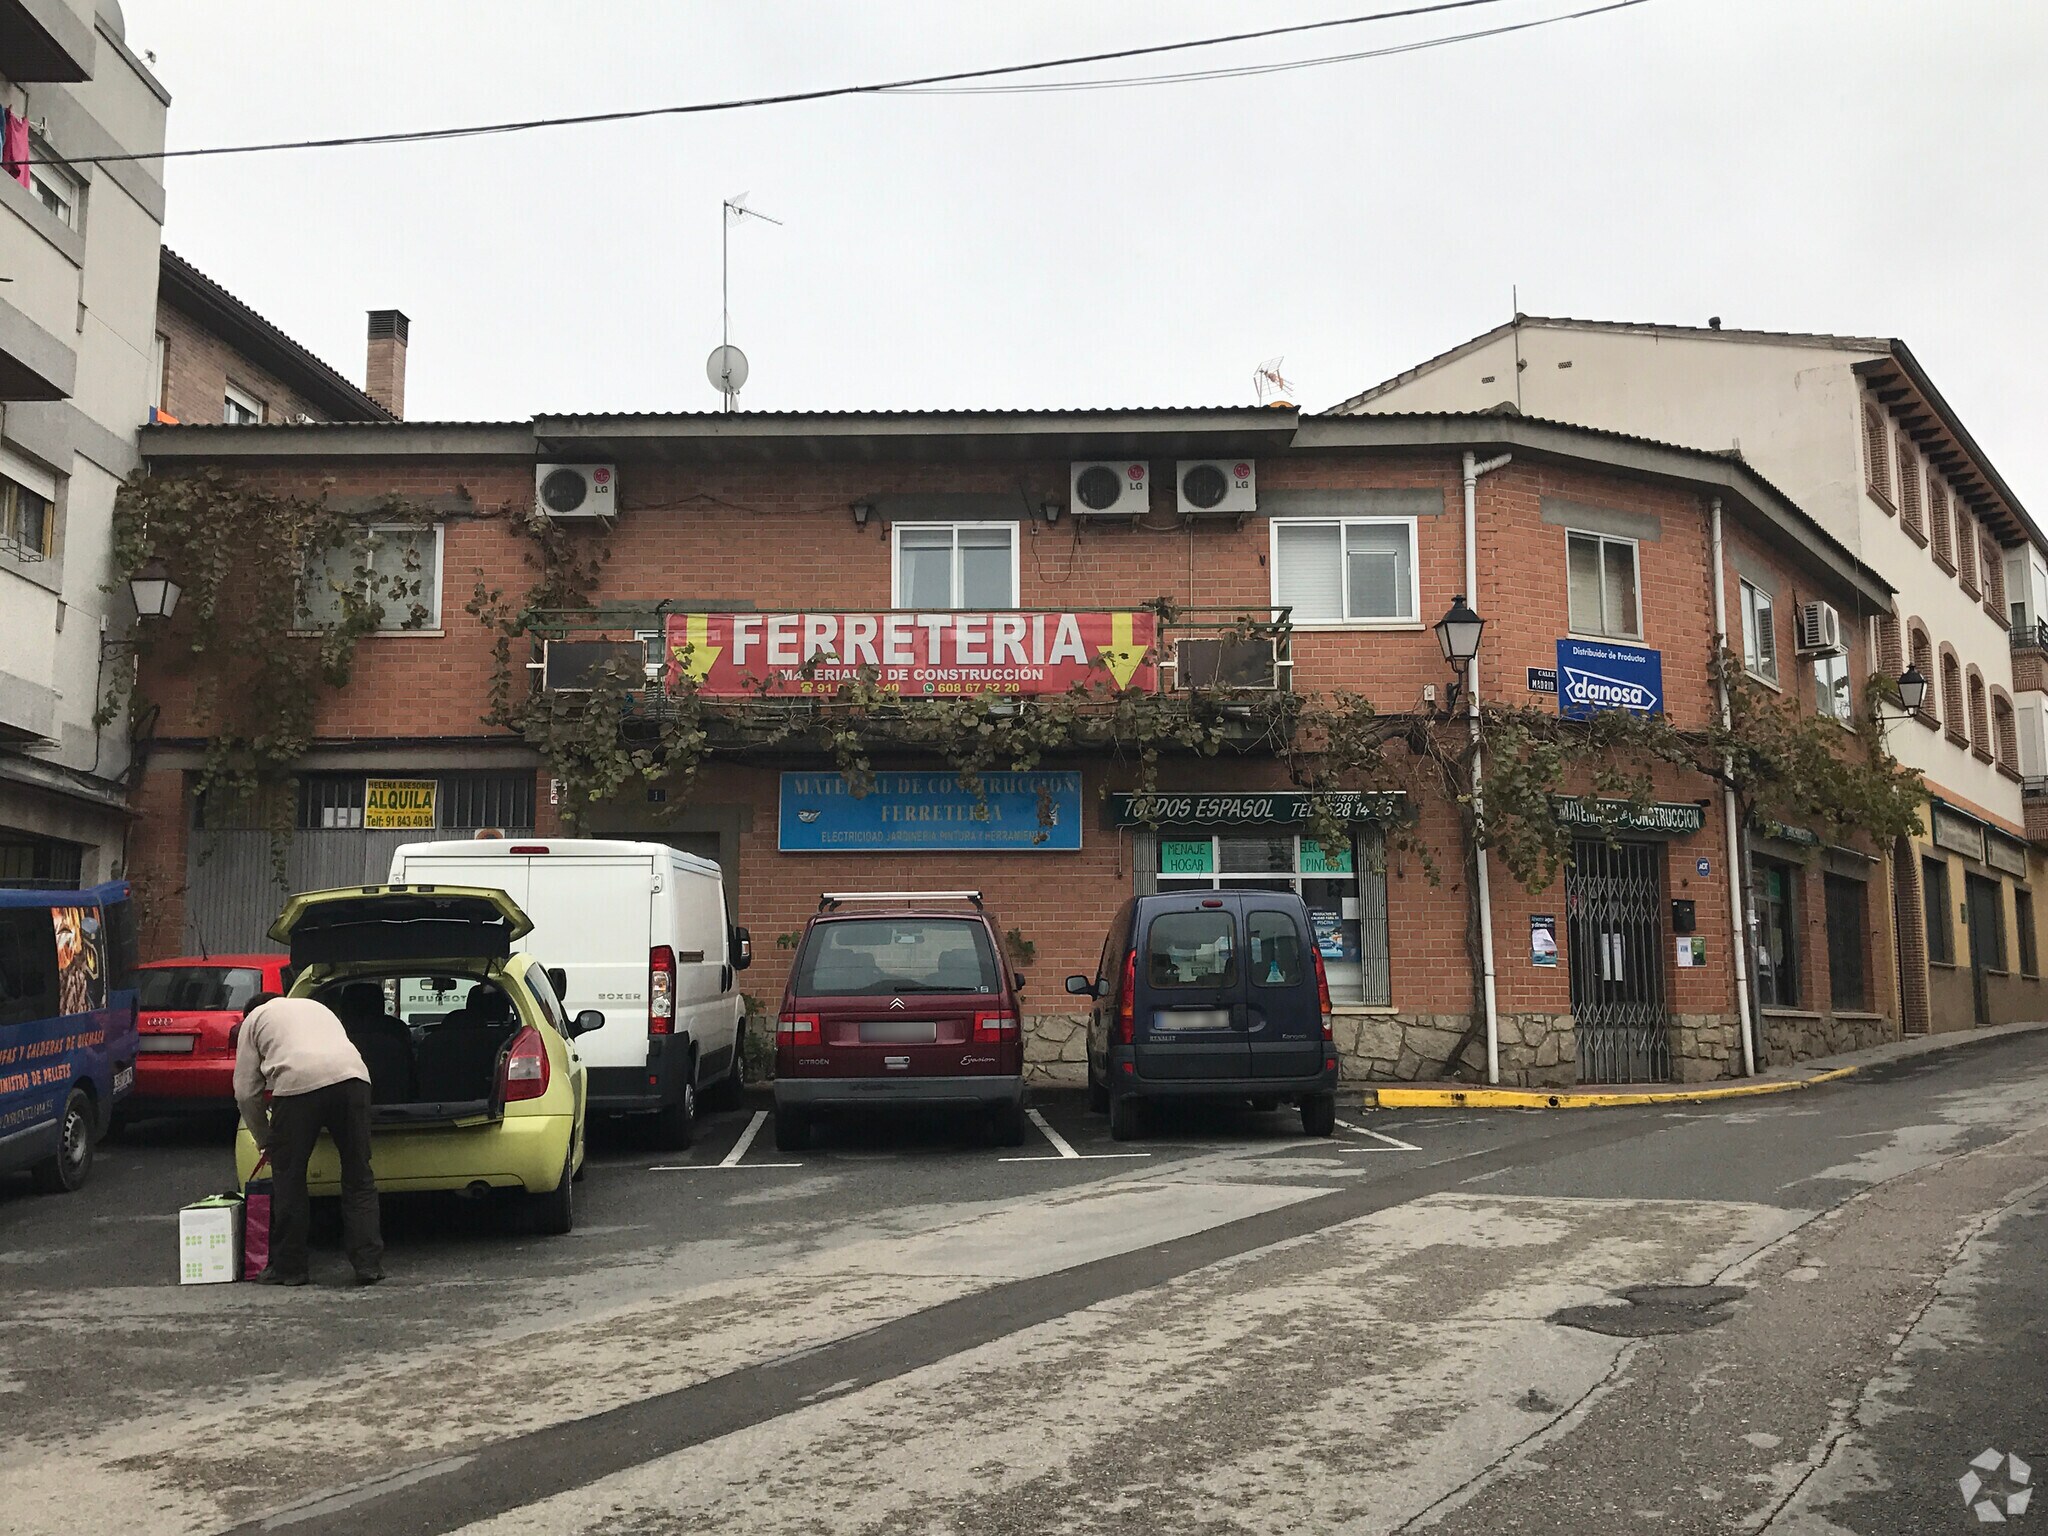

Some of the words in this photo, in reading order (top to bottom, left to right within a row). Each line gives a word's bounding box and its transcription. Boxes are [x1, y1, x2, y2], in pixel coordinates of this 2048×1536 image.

[1130, 482, 1143, 490] LG
[1235, 481, 1249, 489] LG
[732, 613, 1089, 666] FERRETERIA
[1572, 646, 1607, 659] Distribuidor
[1608, 651, 1616, 660] de
[1618, 652, 1646, 664] Productos
[780, 669, 882, 681] MAERIALS
[887, 669, 909, 681] DE
[914, 666, 1044, 680] CONSTRUCCIÓN
[817, 684, 832, 693] 91
[938, 683, 961, 693] 608
[965, 683, 980, 693] 67
[1004, 683, 1020, 693] 20
[1532, 679, 1554, 690] MADRID
[1574, 676, 1642, 704] danosa
[898, 779, 923, 794] DE
[368, 790, 432, 810] ALQUILA
[1195, 798, 1274, 818] ESPASOL
[366, 815, 384, 827] Telf:
[386, 816, 395, 827] 91
[397, 816, 411, 827] 843
[413, 816, 423, 827] 40
[424, 816, 433, 827] 91
[1168, 844, 1206, 855] MENAJE
[1170, 858, 1204, 871] HOGAR
[31, 1070, 42, 1087] DE
[43, 1062, 72, 1084] PELLETS
